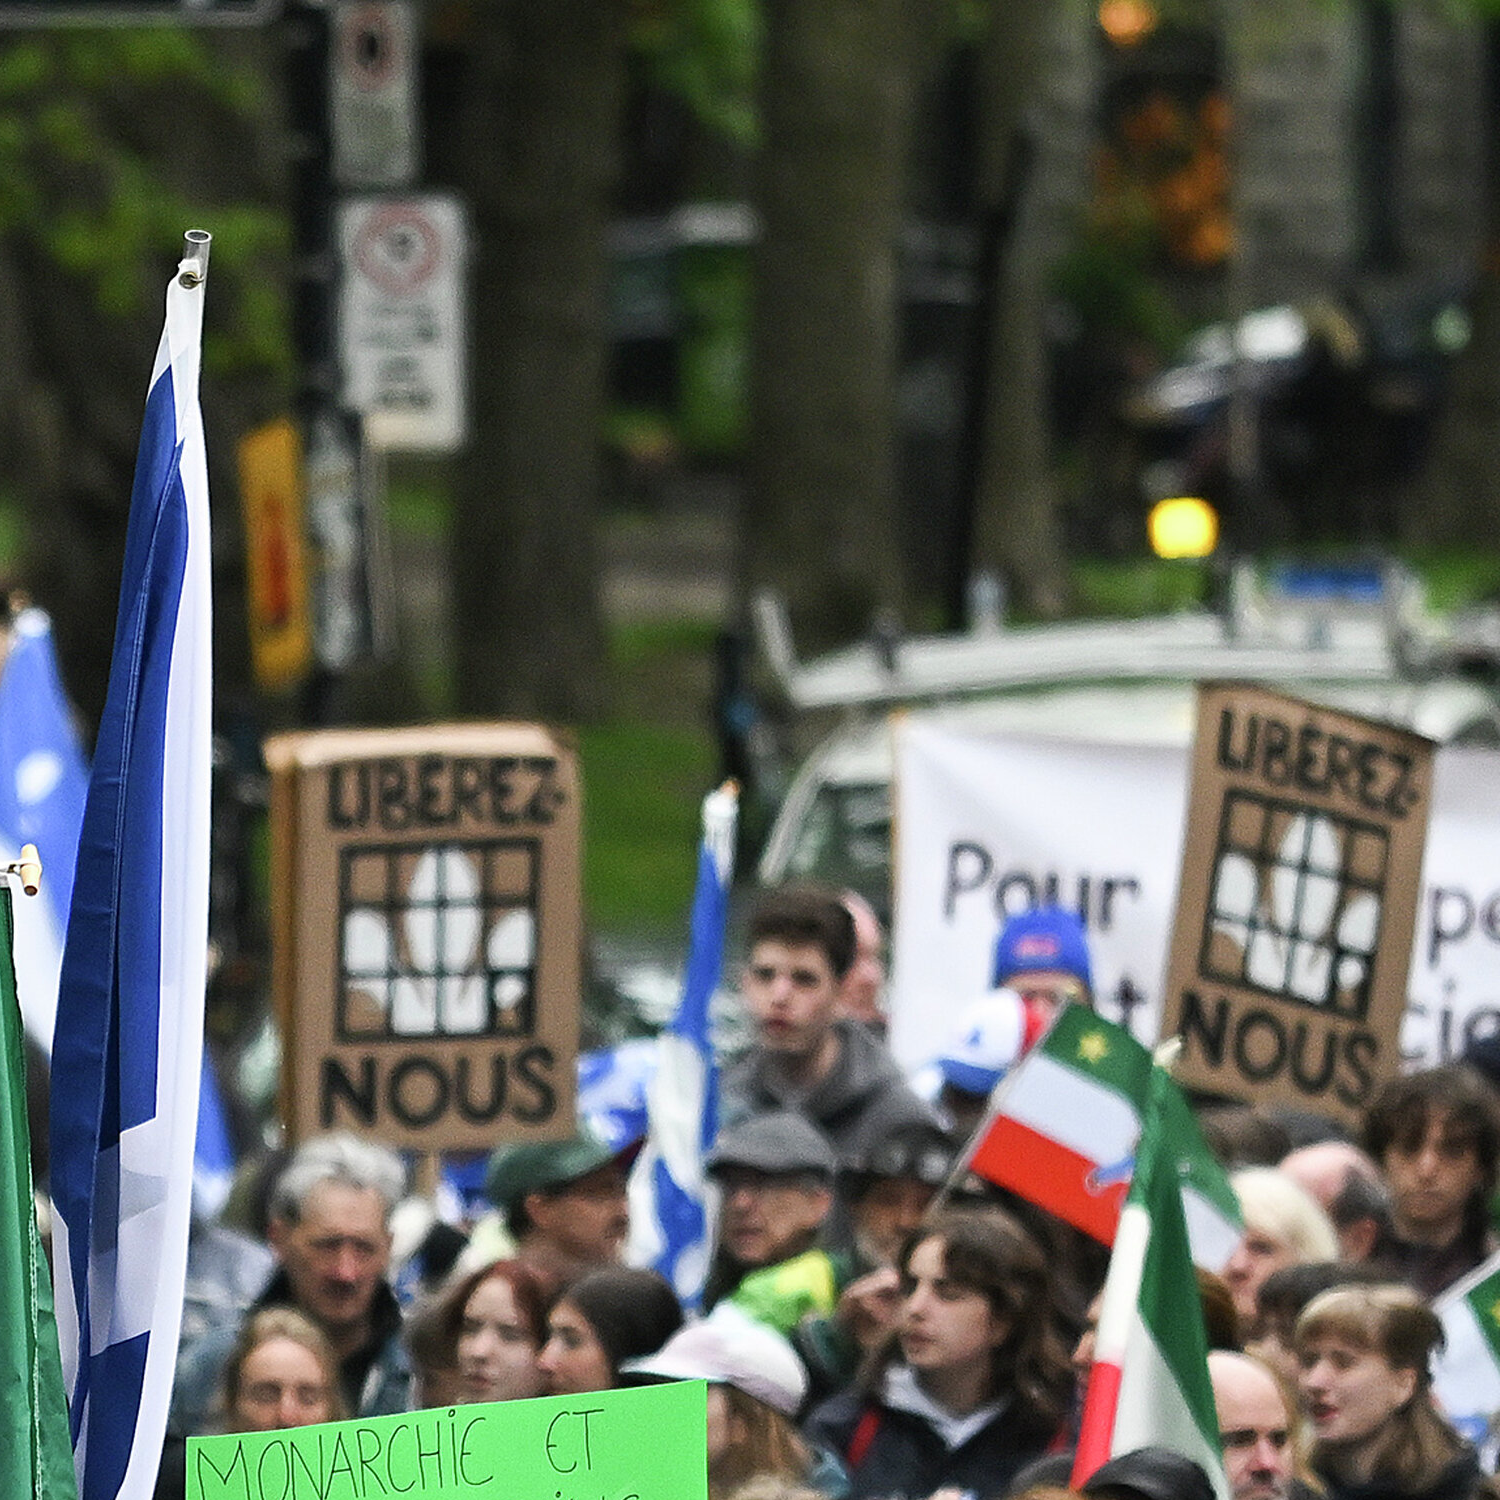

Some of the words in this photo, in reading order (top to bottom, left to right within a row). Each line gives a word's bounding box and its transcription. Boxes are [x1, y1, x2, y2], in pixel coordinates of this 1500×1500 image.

[1180, 988, 1378, 1104] NOUS
[320, 1047, 557, 1130] NOUS
[545, 1408, 604, 1474] ET
